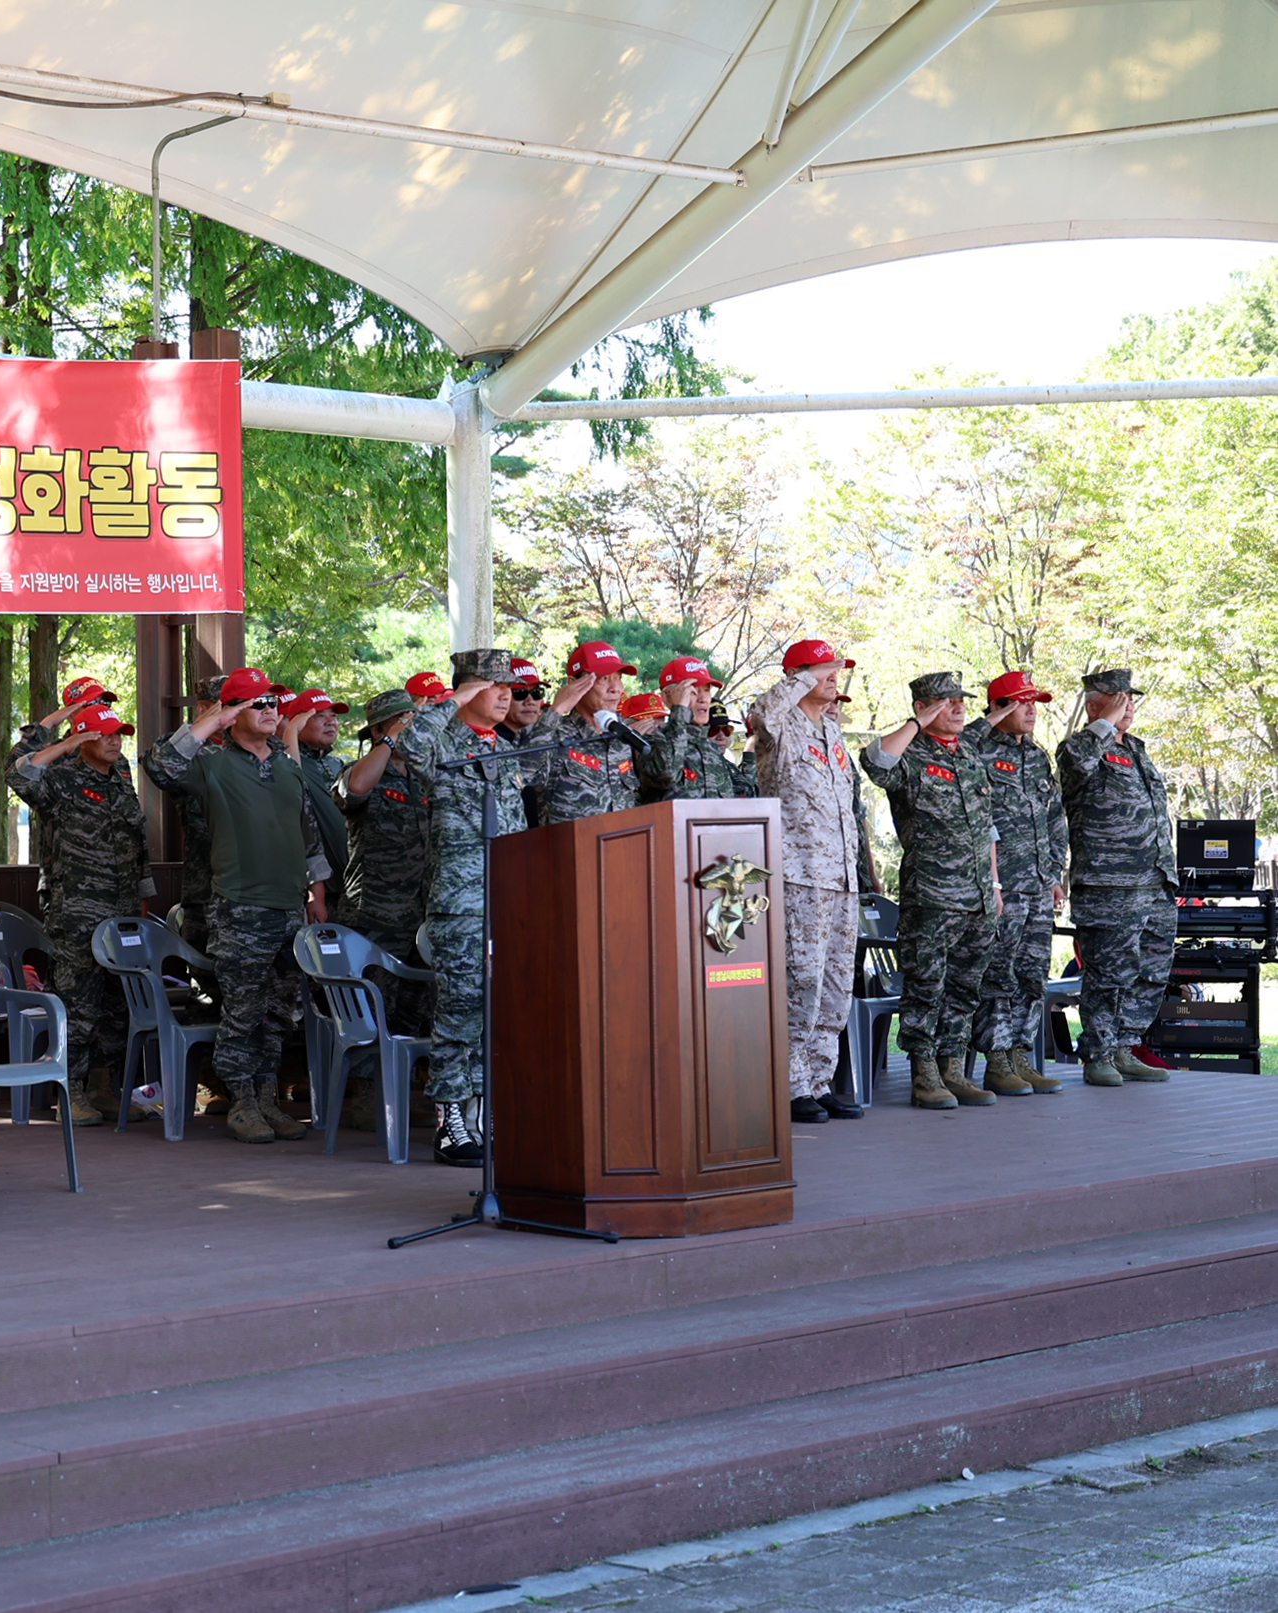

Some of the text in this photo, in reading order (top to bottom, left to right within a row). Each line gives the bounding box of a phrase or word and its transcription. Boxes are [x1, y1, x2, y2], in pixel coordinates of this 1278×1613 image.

[20, 572, 80, 594] 지원받아
[84, 573, 142, 594] 실시하는
[146, 573, 223, 594] 행사입니다.
[1176, 1006, 1190, 1014] JBL
